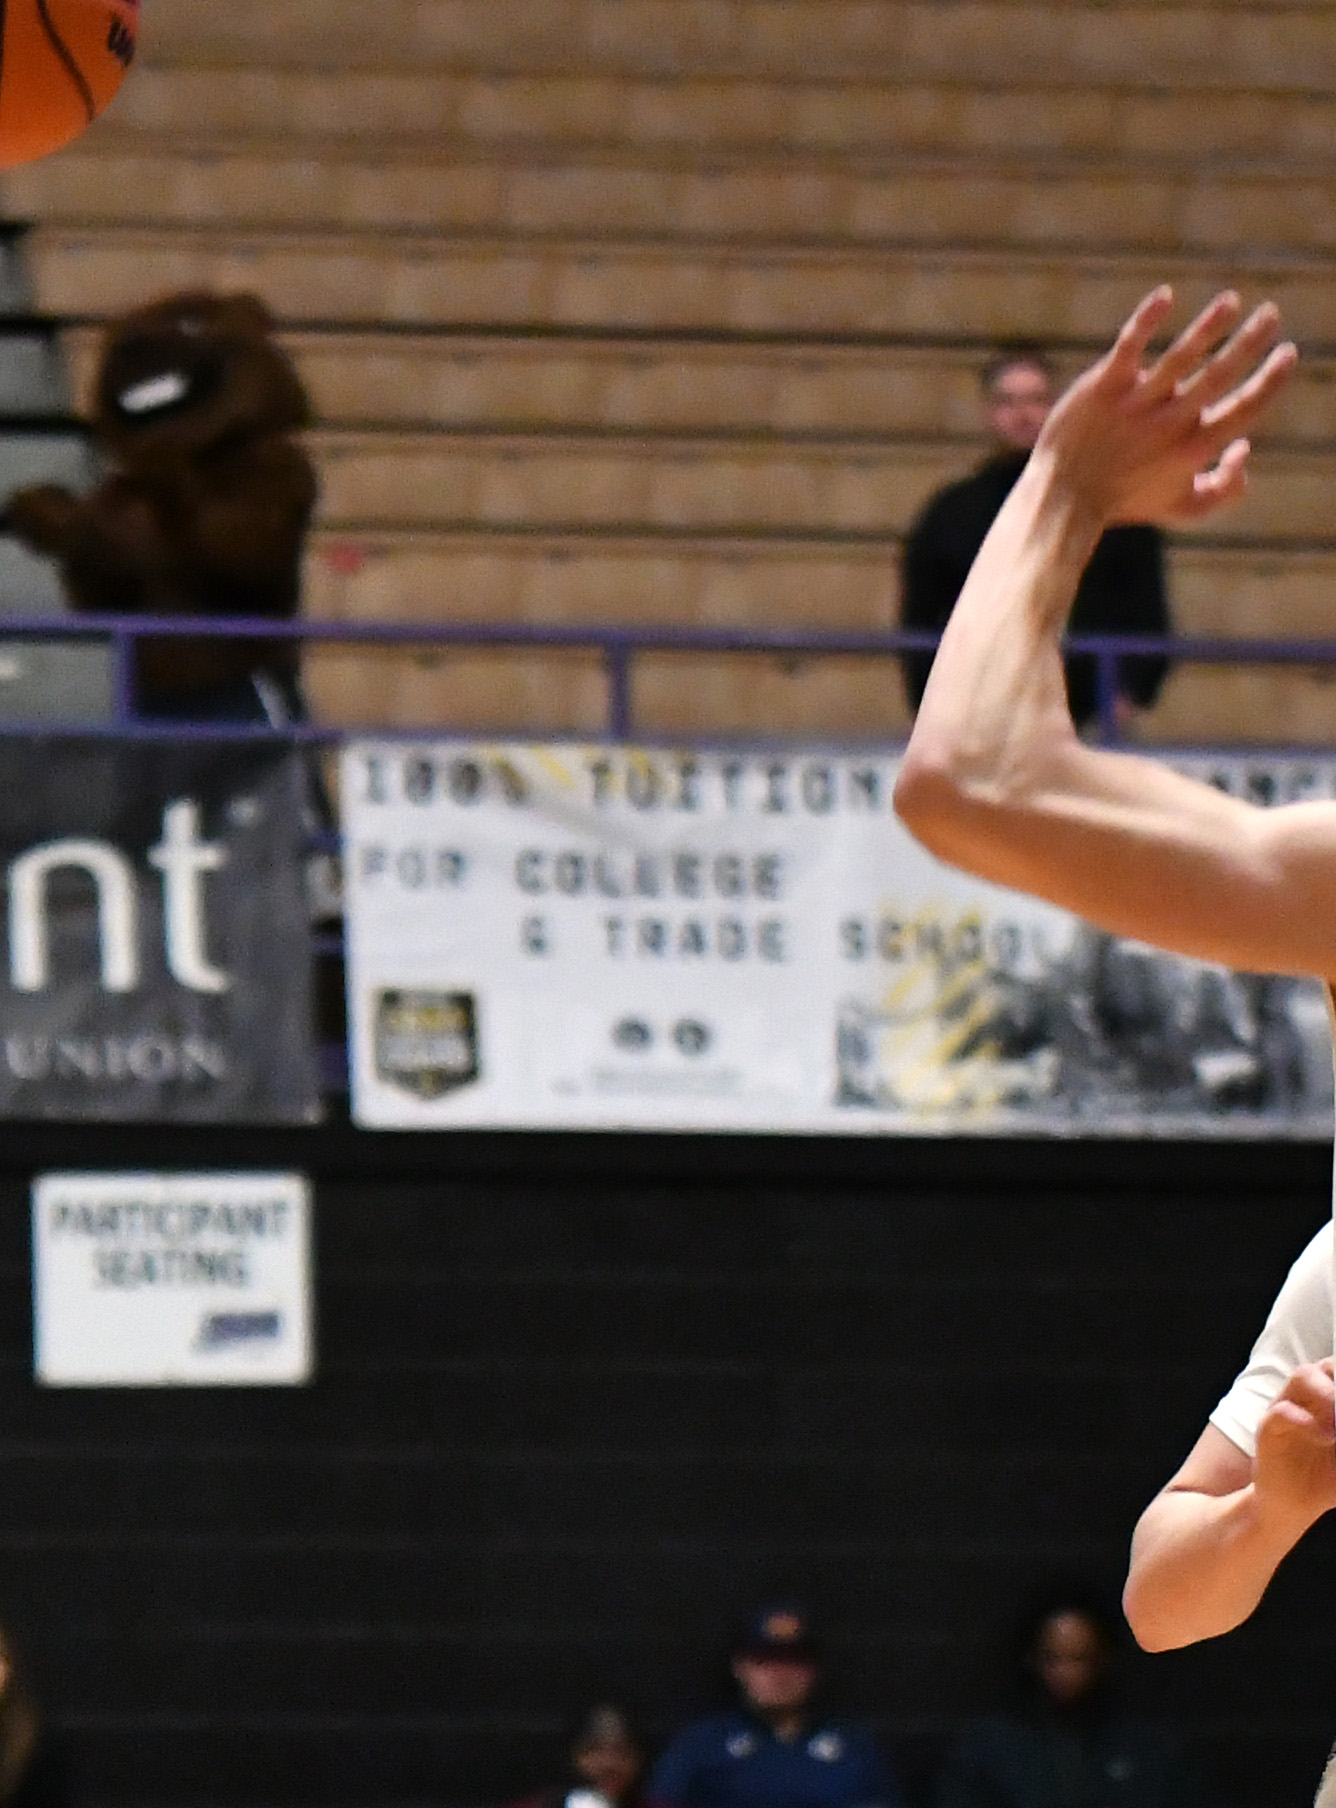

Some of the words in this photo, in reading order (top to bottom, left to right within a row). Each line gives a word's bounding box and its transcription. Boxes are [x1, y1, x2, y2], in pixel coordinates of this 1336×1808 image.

[588, 756, 884, 816] TUITION
[362, 844, 468, 890] FOR
[516, 847, 788, 902] COLLEGE
[600, 914, 790, 964] TRADE
[5, 1036, 228, 1082] UNION
